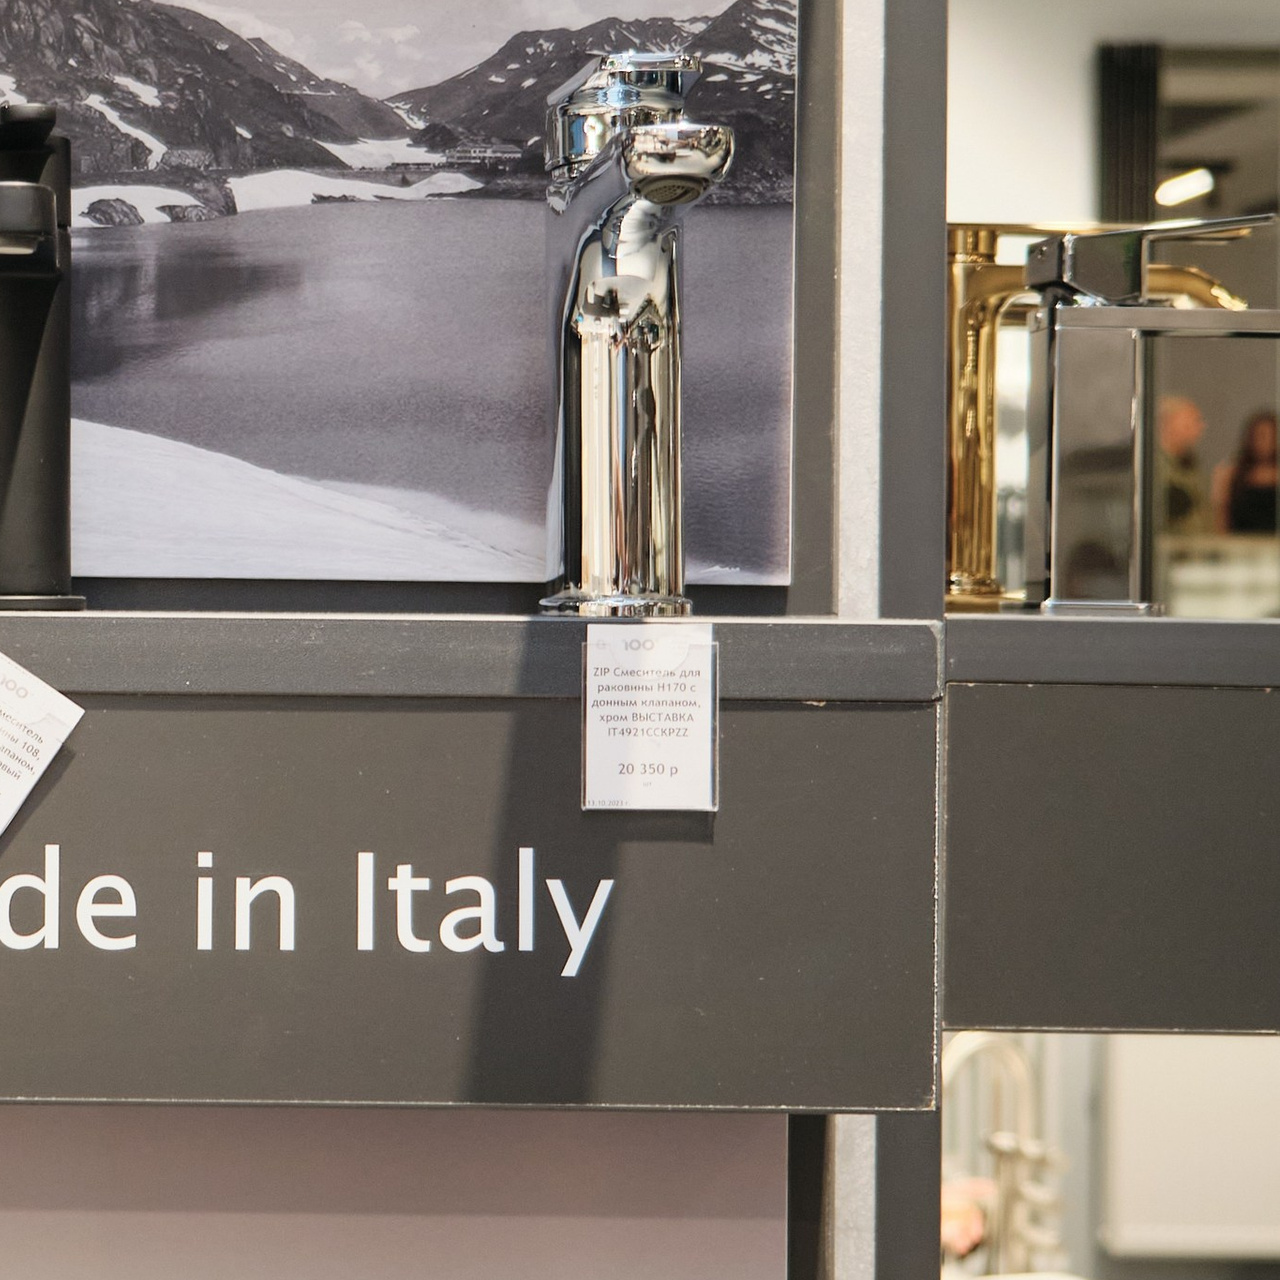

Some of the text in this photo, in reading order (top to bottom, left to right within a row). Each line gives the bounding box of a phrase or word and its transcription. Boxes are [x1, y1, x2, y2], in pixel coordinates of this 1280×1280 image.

[594, 668, 700, 677] ZIP Смеситель для
[598, 684, 653, 693] раковины
[591, 699, 701, 708] донным клапаном,
[600, 713, 694, 723] хром ВЫСТАВКА
[618, 764, 634, 774] 20
[640, 764, 665, 774] 350
[197, 851, 295, 951] in
[357, 847, 614, 977] Italy
